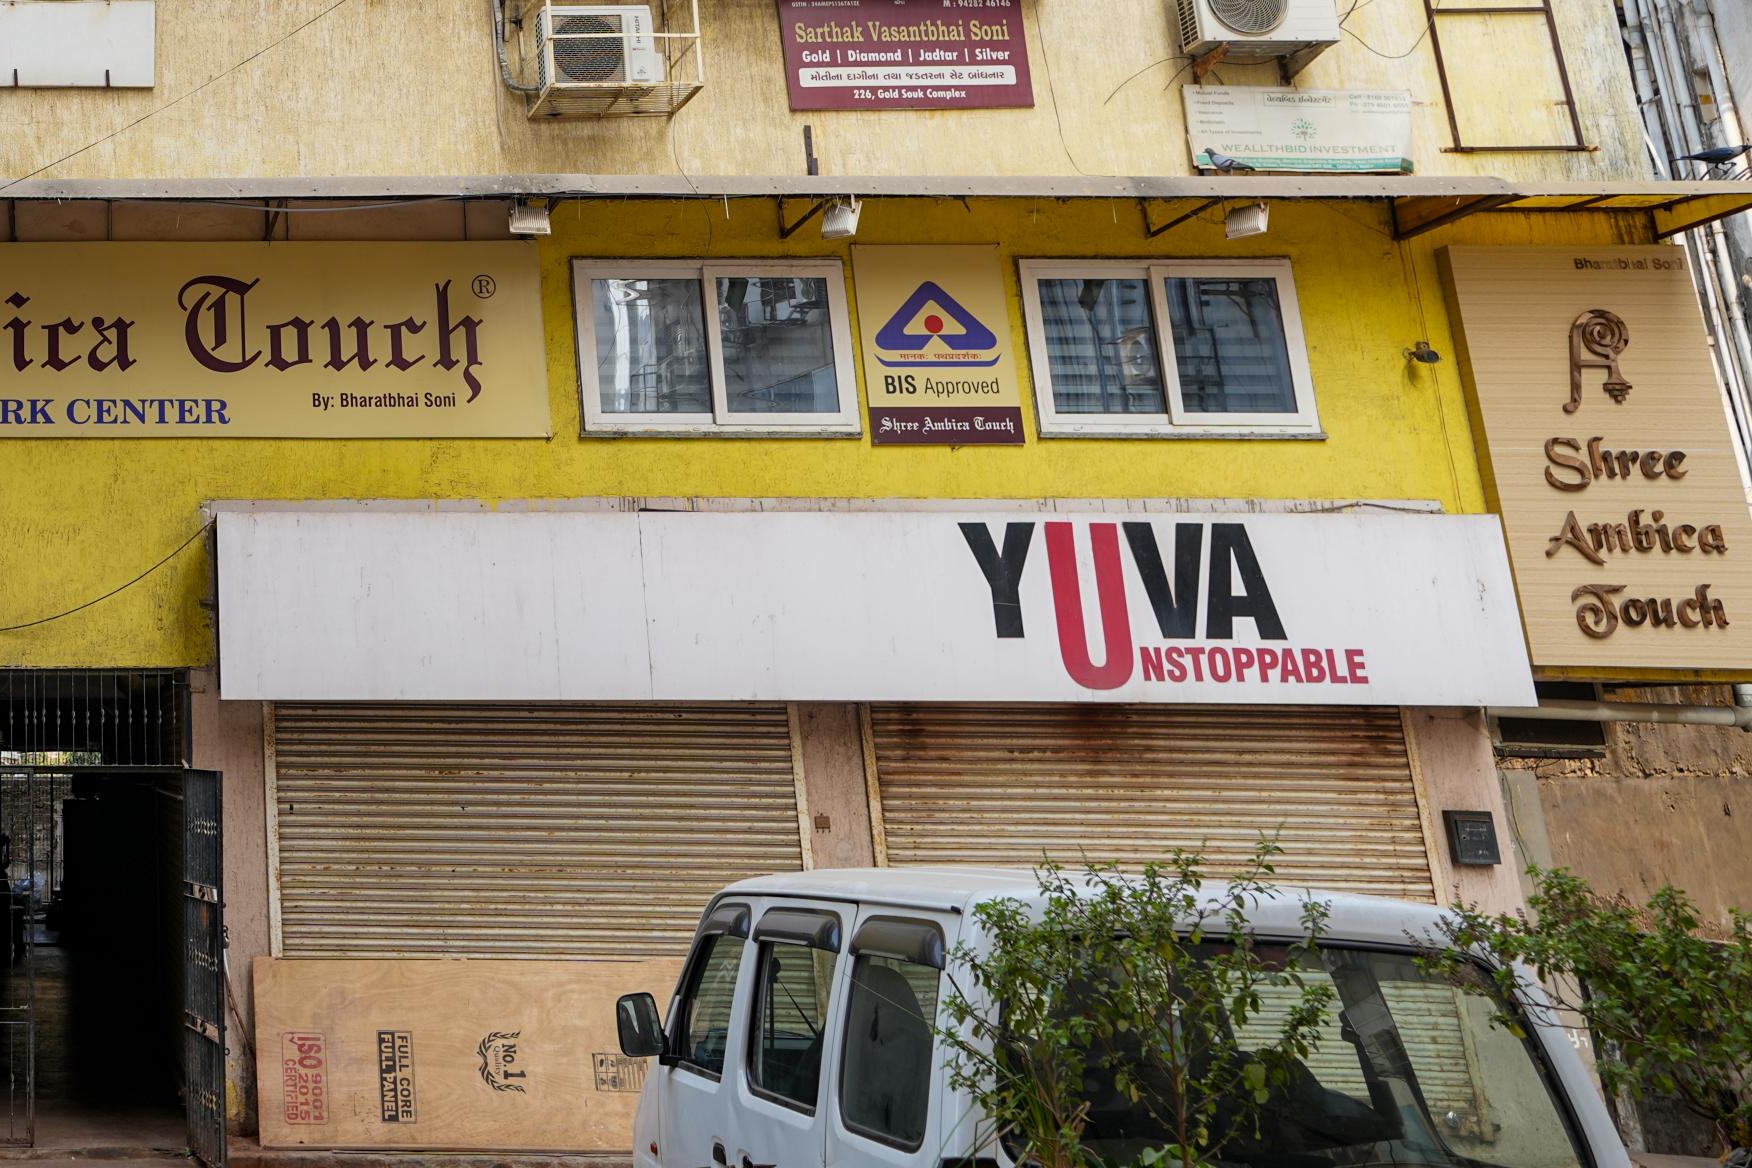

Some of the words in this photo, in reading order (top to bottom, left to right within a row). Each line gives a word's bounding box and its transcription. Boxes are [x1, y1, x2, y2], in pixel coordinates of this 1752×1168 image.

[958, 0, 983, 7] 94282
[986, 0, 1011, 7] 46146
[795, 21, 864, 43] Sarthak
[868, 19, 965, 42] Vasantbhai
[970, 19, 1010, 41] Soni
[802, 50, 830, 62] Gold
[848, 49, 902, 62] Diamond
[919, 49, 958, 61] Jadtar
[975, 48, 1010, 60] Silver
[811, 71, 842, 81] મોતીના
[847, 70, 879, 80] દાગીના
[906, 72, 945, 80] જડતરના
[949, 70, 963, 80] સેટ
[854, 89, 875, 100] 226,
[878, 89, 898, 98] Gold
[901, 89, 924, 98] Souk
[927, 88, 966, 100] Complex
[1310, 144, 1397, 154] INVESTMENT
[177, 274, 483, 404] Touch
[311, 392, 334, 410] By:
[340, 391, 420, 409] Bharatbhai
[424, 391, 456, 408] Soni
[884, 375, 917, 395] BIS
[924, 377, 1000, 398] Approved
[66, 399, 230, 425] CENTER
[880, 416, 919, 434] Shree
[923, 416, 970, 434] Ambica
[974, 416, 1015, 434] Touch
[1545, 436, 1688, 492] Shree
[1545, 509, 1729, 565] Ambica
[957, 522, 1288, 690] YUVA
[1571, 583, 1730, 639] Touch
[380, 1034, 393, 1069] FULL
[397, 1036, 409, 1072] FULL
[284, 1058, 298, 1120] CERTIFIED
[297, 1036, 322, 1069] ISO
[312, 1073, 324, 1121] 9001
[383, 1072, 396, 1119] PANEL
[298, 1073, 310, 1120] 2015
[399, 1077, 412, 1118] CORE
